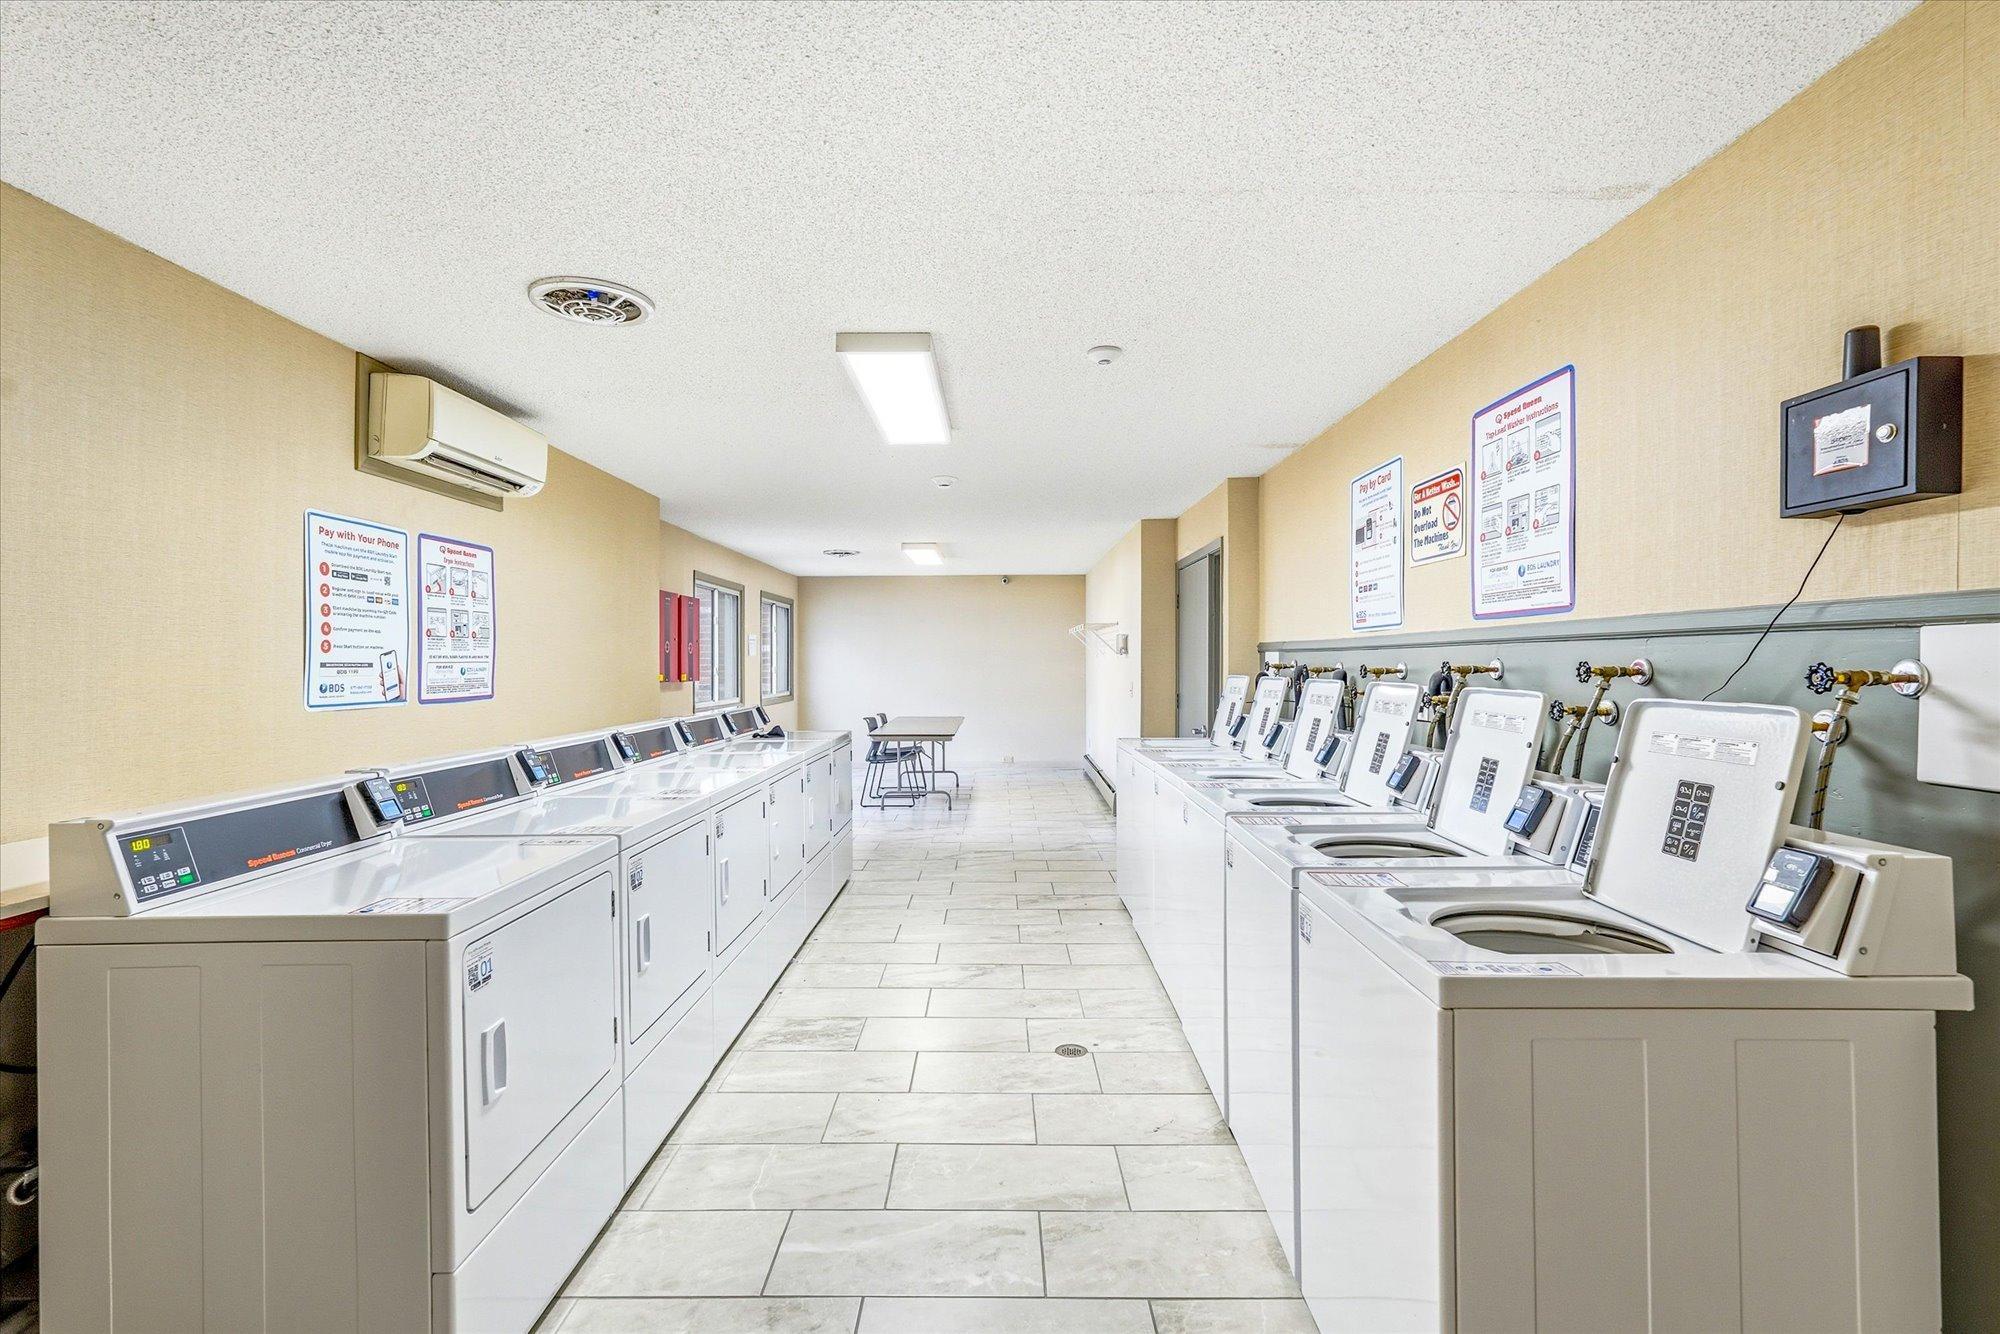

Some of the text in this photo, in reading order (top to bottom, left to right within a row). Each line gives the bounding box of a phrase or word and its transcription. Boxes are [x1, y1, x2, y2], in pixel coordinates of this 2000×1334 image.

[1503, 405, 1521, 420] Speed
[1522, 396, 1542, 409] Queen
[1507, 417, 1525, 432] Washer
[1526, 402, 1559, 422] Instructions
[1359, 470, 1392, 494] Pay by Card
[1414, 506, 1432, 519] Do Not
[1413, 517, 1438, 534] Overload
[319, 526, 400, 550] Pay with Your Phone
[1413, 532, 1449, 548] The Machines
[328, 683, 345, 693] BDS
[247, 854, 272, 868] Speed
[272, 849, 296, 861] Queen
[480, 957, 493, 977] 01
